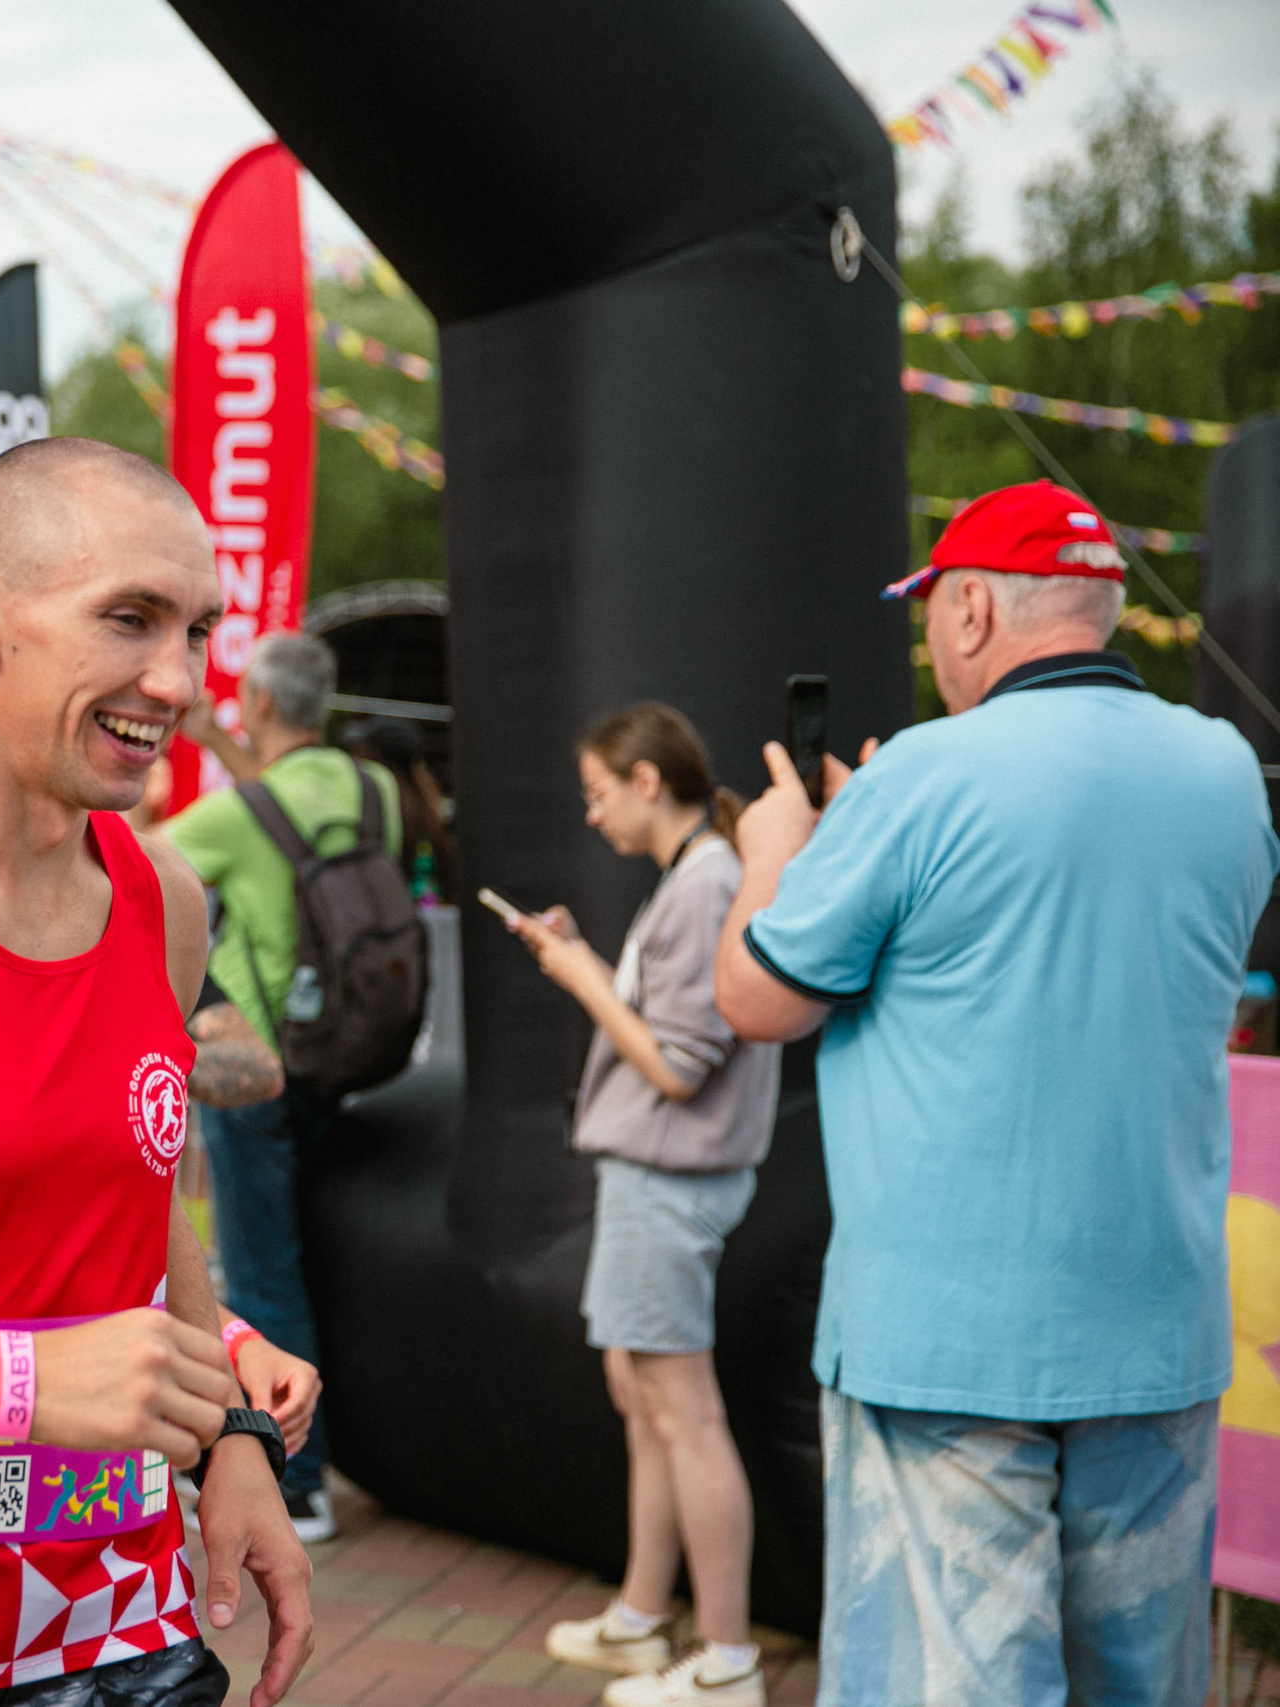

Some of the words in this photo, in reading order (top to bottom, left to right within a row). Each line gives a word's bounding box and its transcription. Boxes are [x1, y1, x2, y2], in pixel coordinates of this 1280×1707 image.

[206, 305, 275, 676] azimut
[129, 1052, 162, 1092] GOLDEN
[141, 1144, 168, 1177] ULTRA
